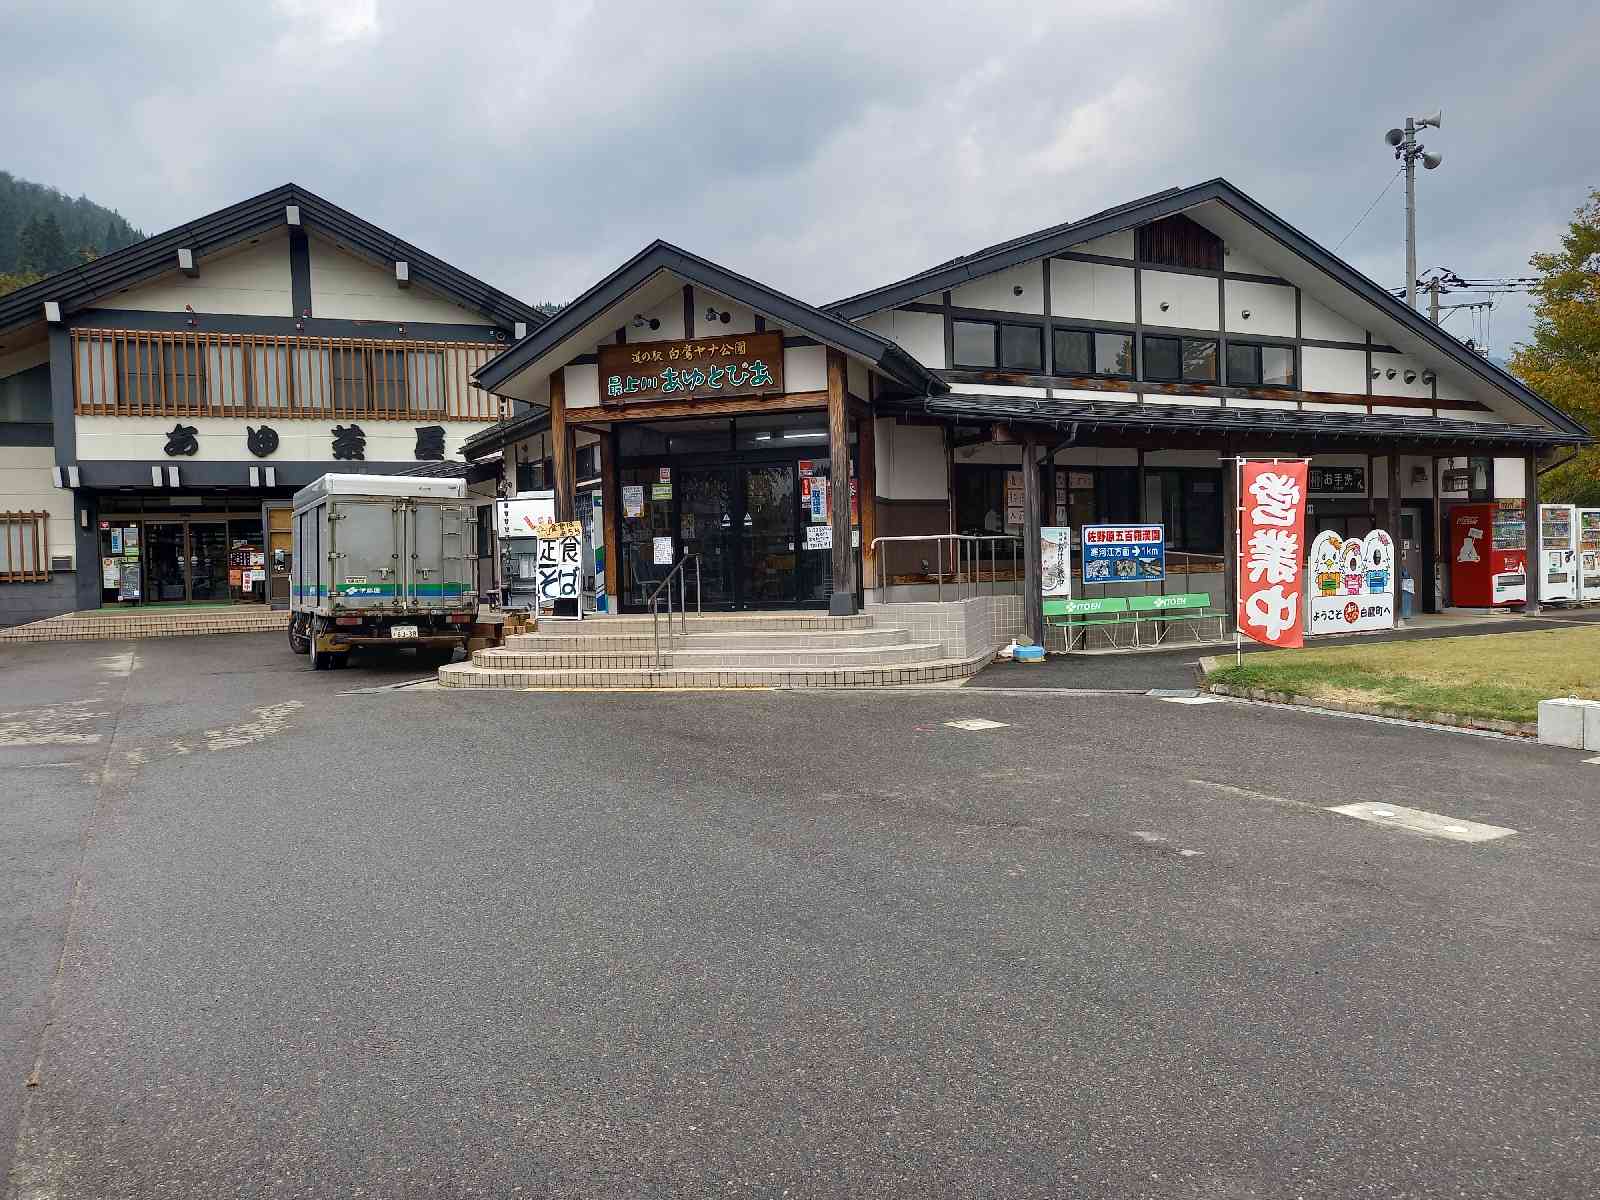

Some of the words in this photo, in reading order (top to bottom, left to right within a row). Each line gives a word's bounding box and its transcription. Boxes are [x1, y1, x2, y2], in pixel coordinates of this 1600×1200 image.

[631, 351, 664, 364] 道の駅
[164, 423, 446, 461] あゆ茶屋
[1141, 546, 1159, 557] 1km
[1245, 472, 1301, 641] 営業中
[538, 566, 581, 599] そば
[1312, 609, 1343, 622] ようこそ
